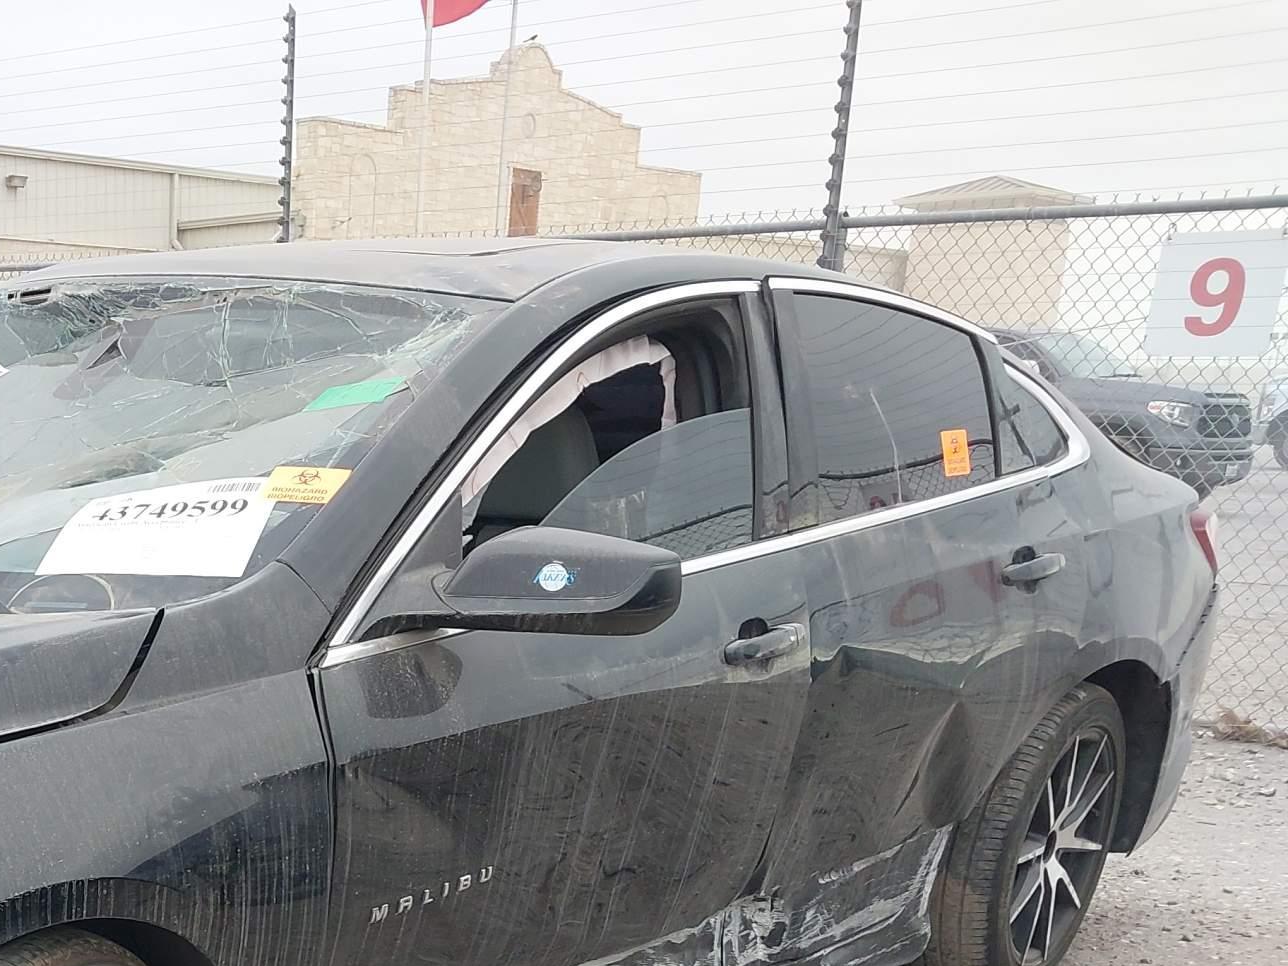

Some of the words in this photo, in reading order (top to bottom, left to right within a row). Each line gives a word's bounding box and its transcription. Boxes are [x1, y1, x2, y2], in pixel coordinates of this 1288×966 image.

[1184, 257, 1246, 337] 9
[92, 498, 249, 521] 43749599
[271, 486, 328, 495] BIOHAZARD
[369, 865, 493, 924] MALIBU
